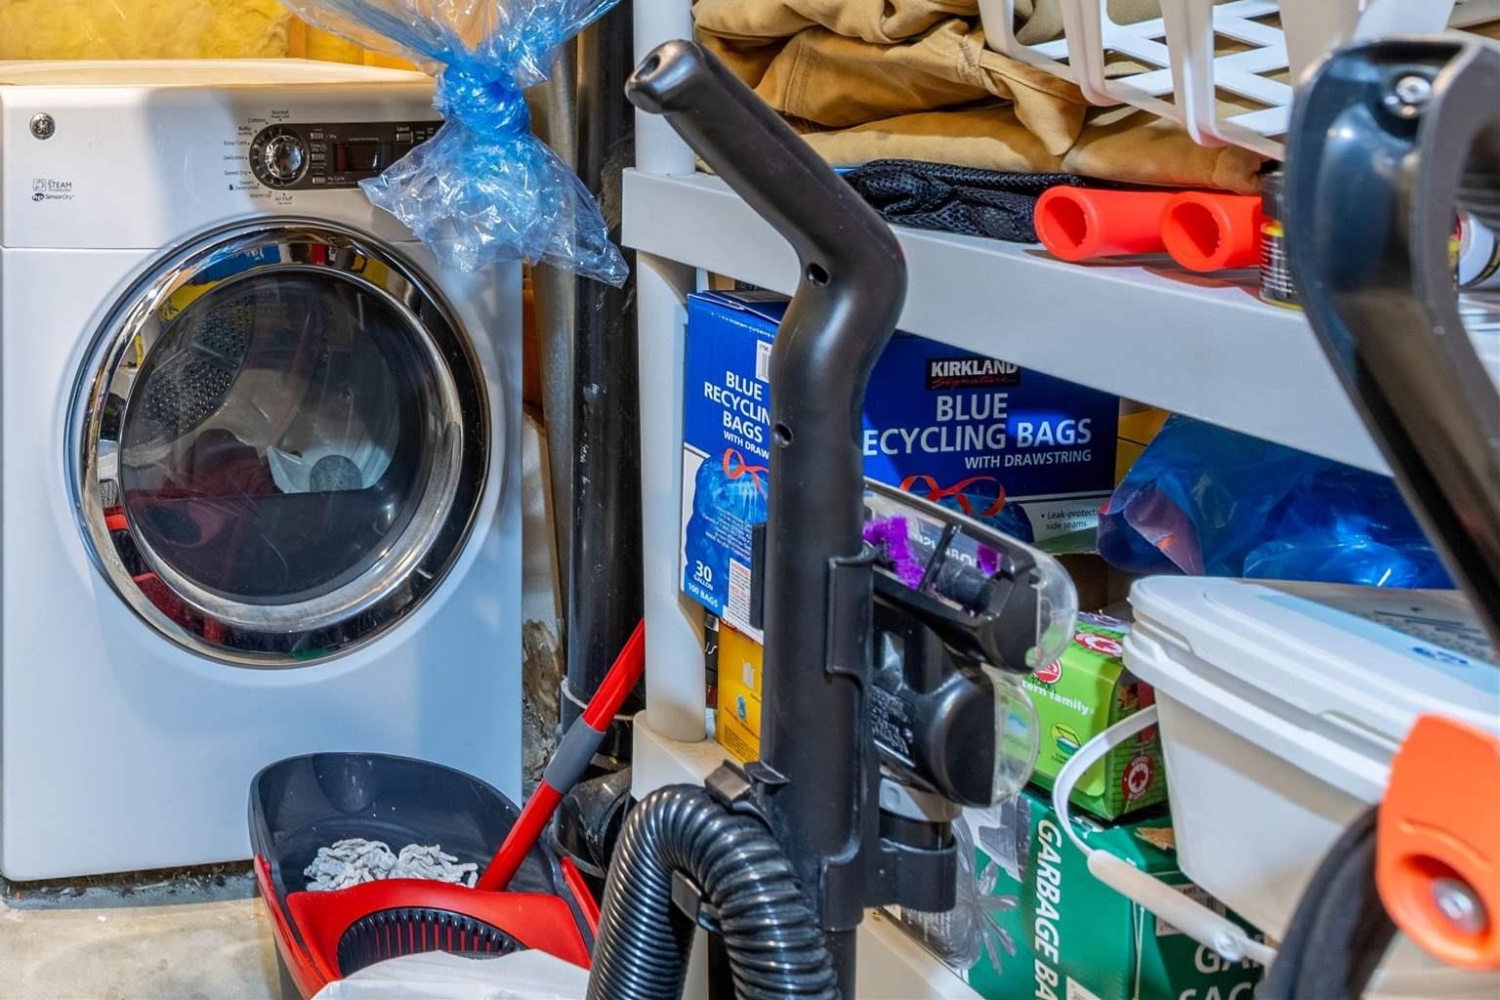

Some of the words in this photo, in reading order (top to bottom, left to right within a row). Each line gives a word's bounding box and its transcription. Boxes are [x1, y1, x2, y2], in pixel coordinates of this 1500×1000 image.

[47, 181, 72, 189] STEAM
[931, 358, 1018, 378] KIRKLAND
[726, 370, 763, 402] BLUE
[936, 393, 1009, 422] BLUE
[722, 410, 763, 444] BAGS
[723, 429, 744, 447] WITH
[863, 423, 1007, 457] ECYCLING
[1016, 418, 1093, 448] BAGS
[964, 454, 1001, 469] WITH
[1004, 449, 1092, 468] DRAWSTRING
[695, 560, 712, 583] 30
[700, 590, 719, 608] BAGS
[1034, 819, 1063, 965] GARBAGE
